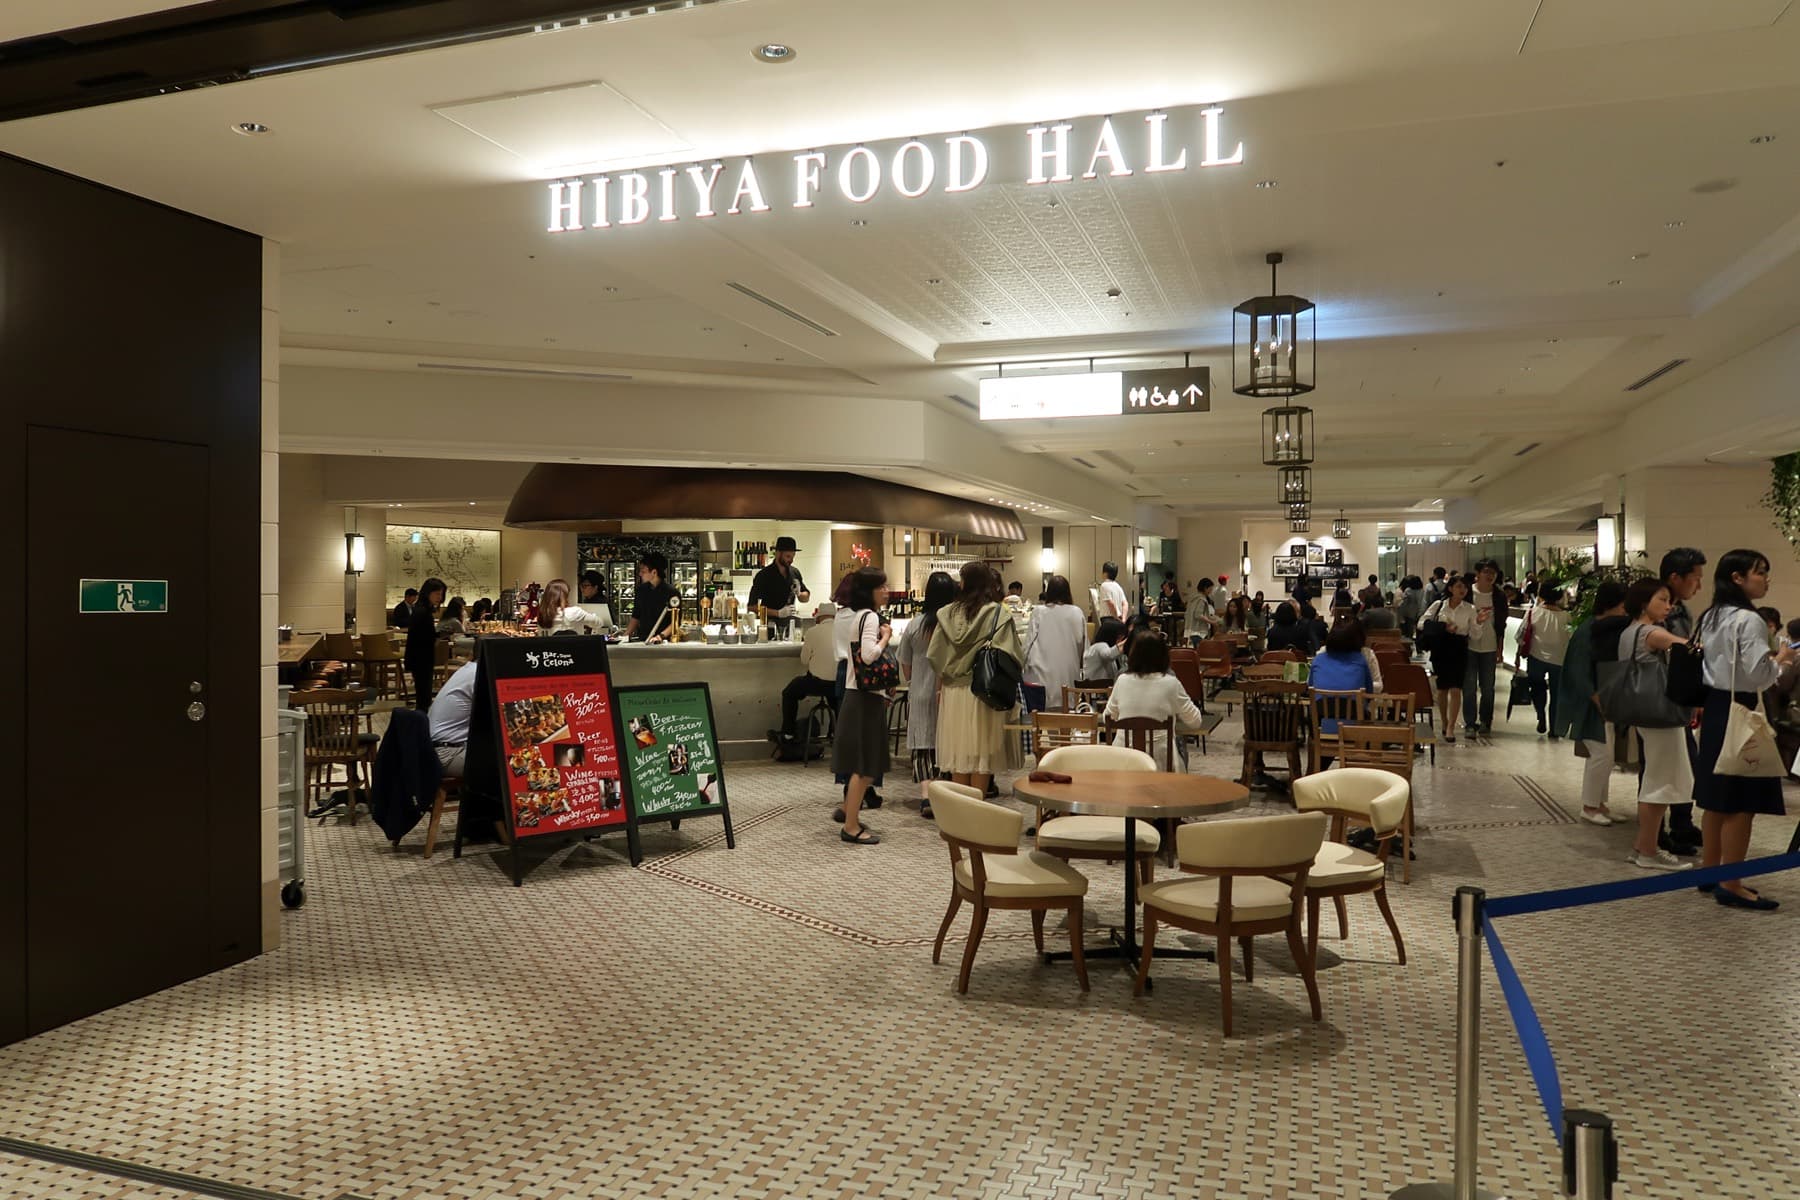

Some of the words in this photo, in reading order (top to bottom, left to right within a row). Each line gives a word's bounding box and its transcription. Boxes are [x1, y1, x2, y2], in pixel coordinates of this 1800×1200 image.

[547, 155, 769, 233] HIBIYA
[793, 134, 989, 208] FOOD
[1026, 105, 1245, 185] HALL
[543, 658, 575, 668] Celona
[649, 712, 677, 727] Beer
[577, 731, 601, 744] Beer
[634, 751, 659, 766] Wine
